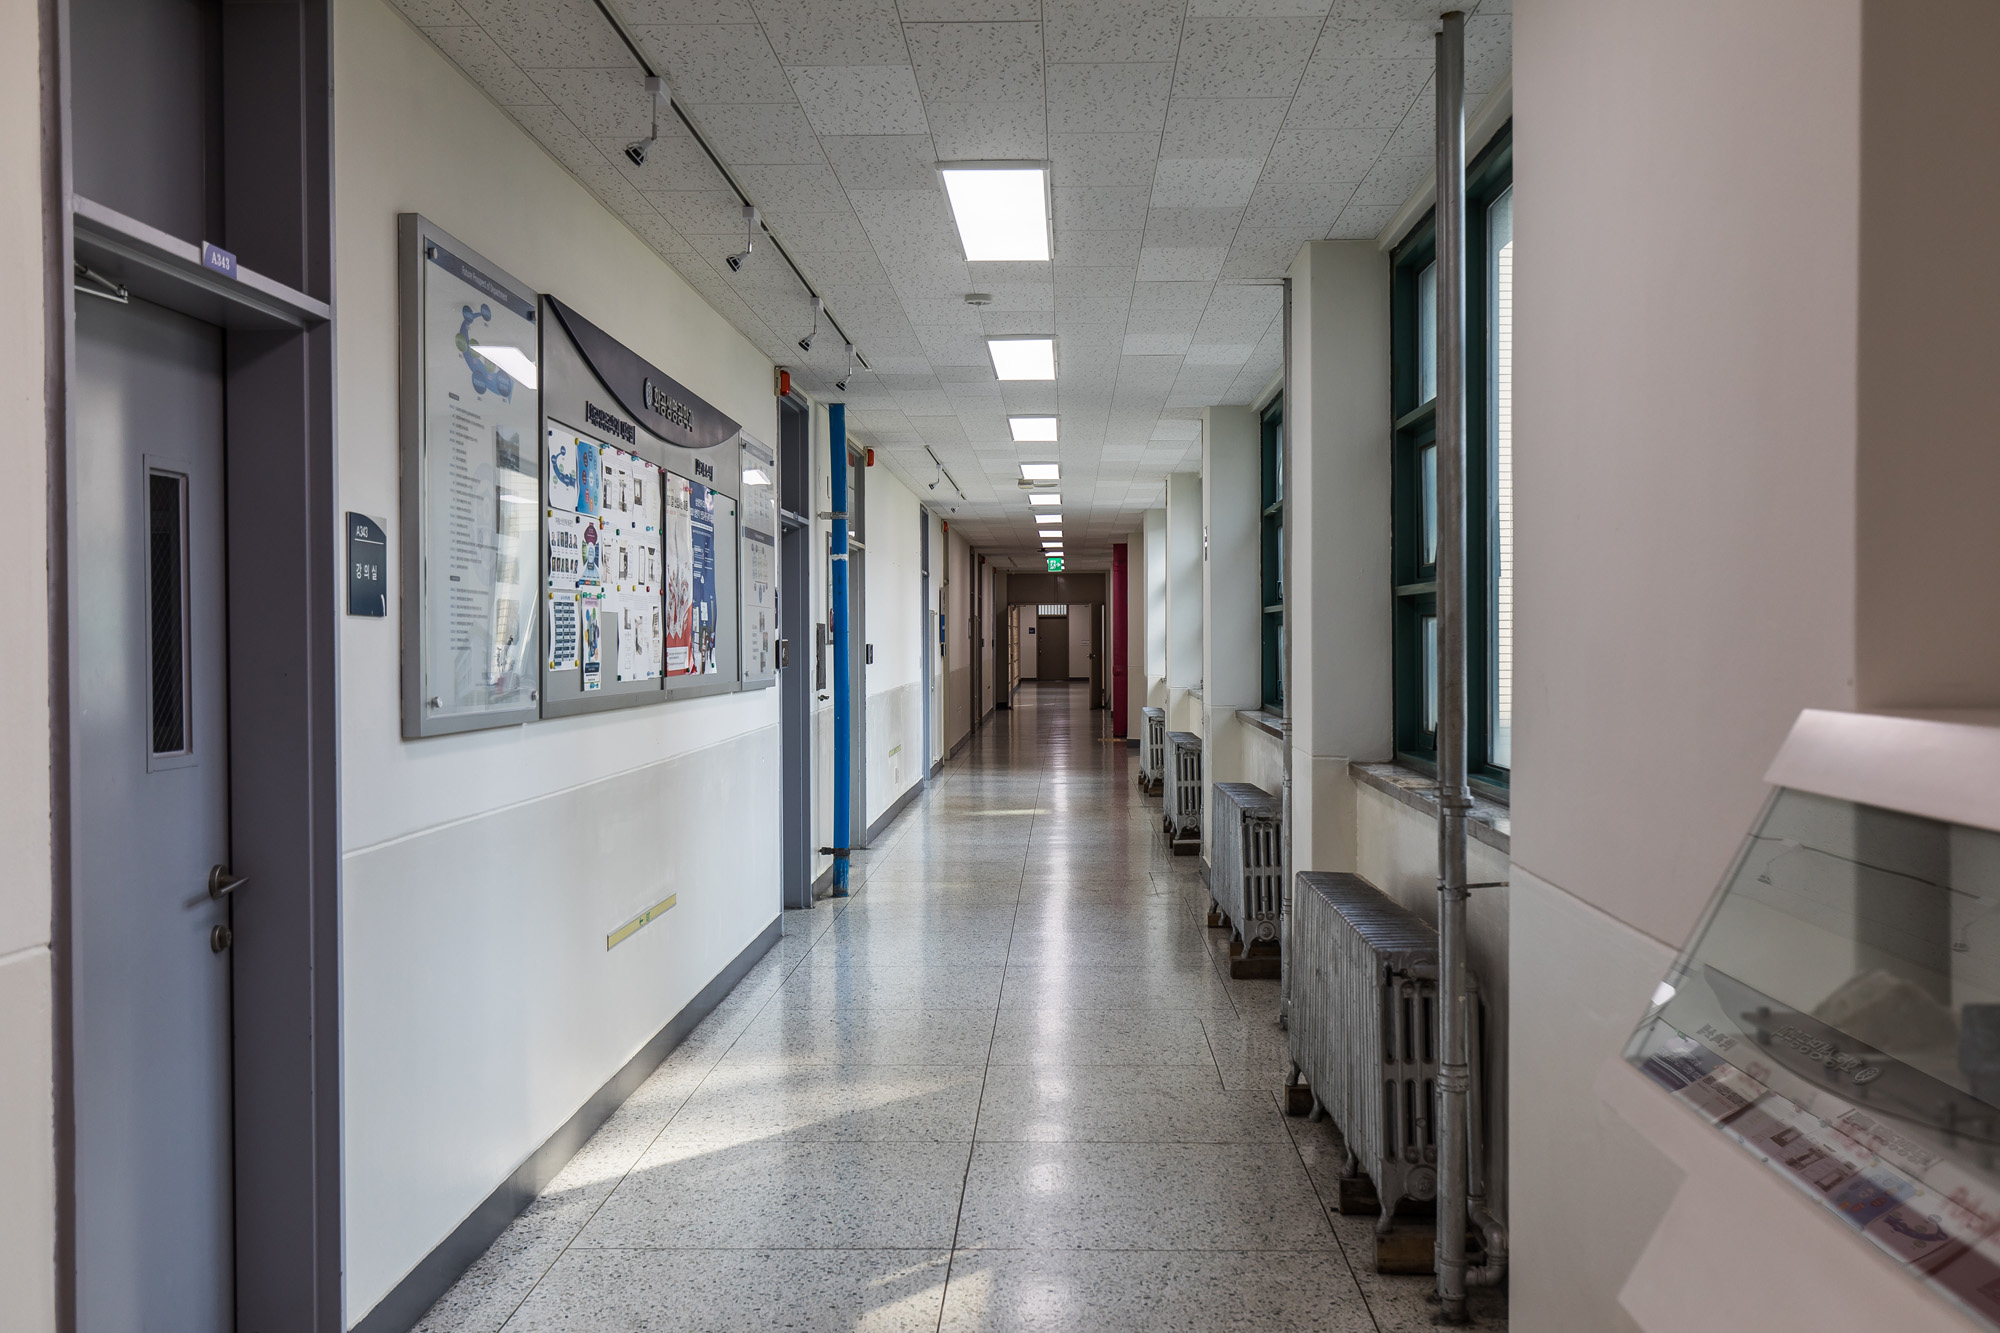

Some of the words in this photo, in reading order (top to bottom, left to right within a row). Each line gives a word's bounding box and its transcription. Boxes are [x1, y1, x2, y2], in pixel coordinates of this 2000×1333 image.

[211, 251, 230, 271] A343
[355, 525, 369, 538] A343
[355, 563, 378, 581] 강의실
